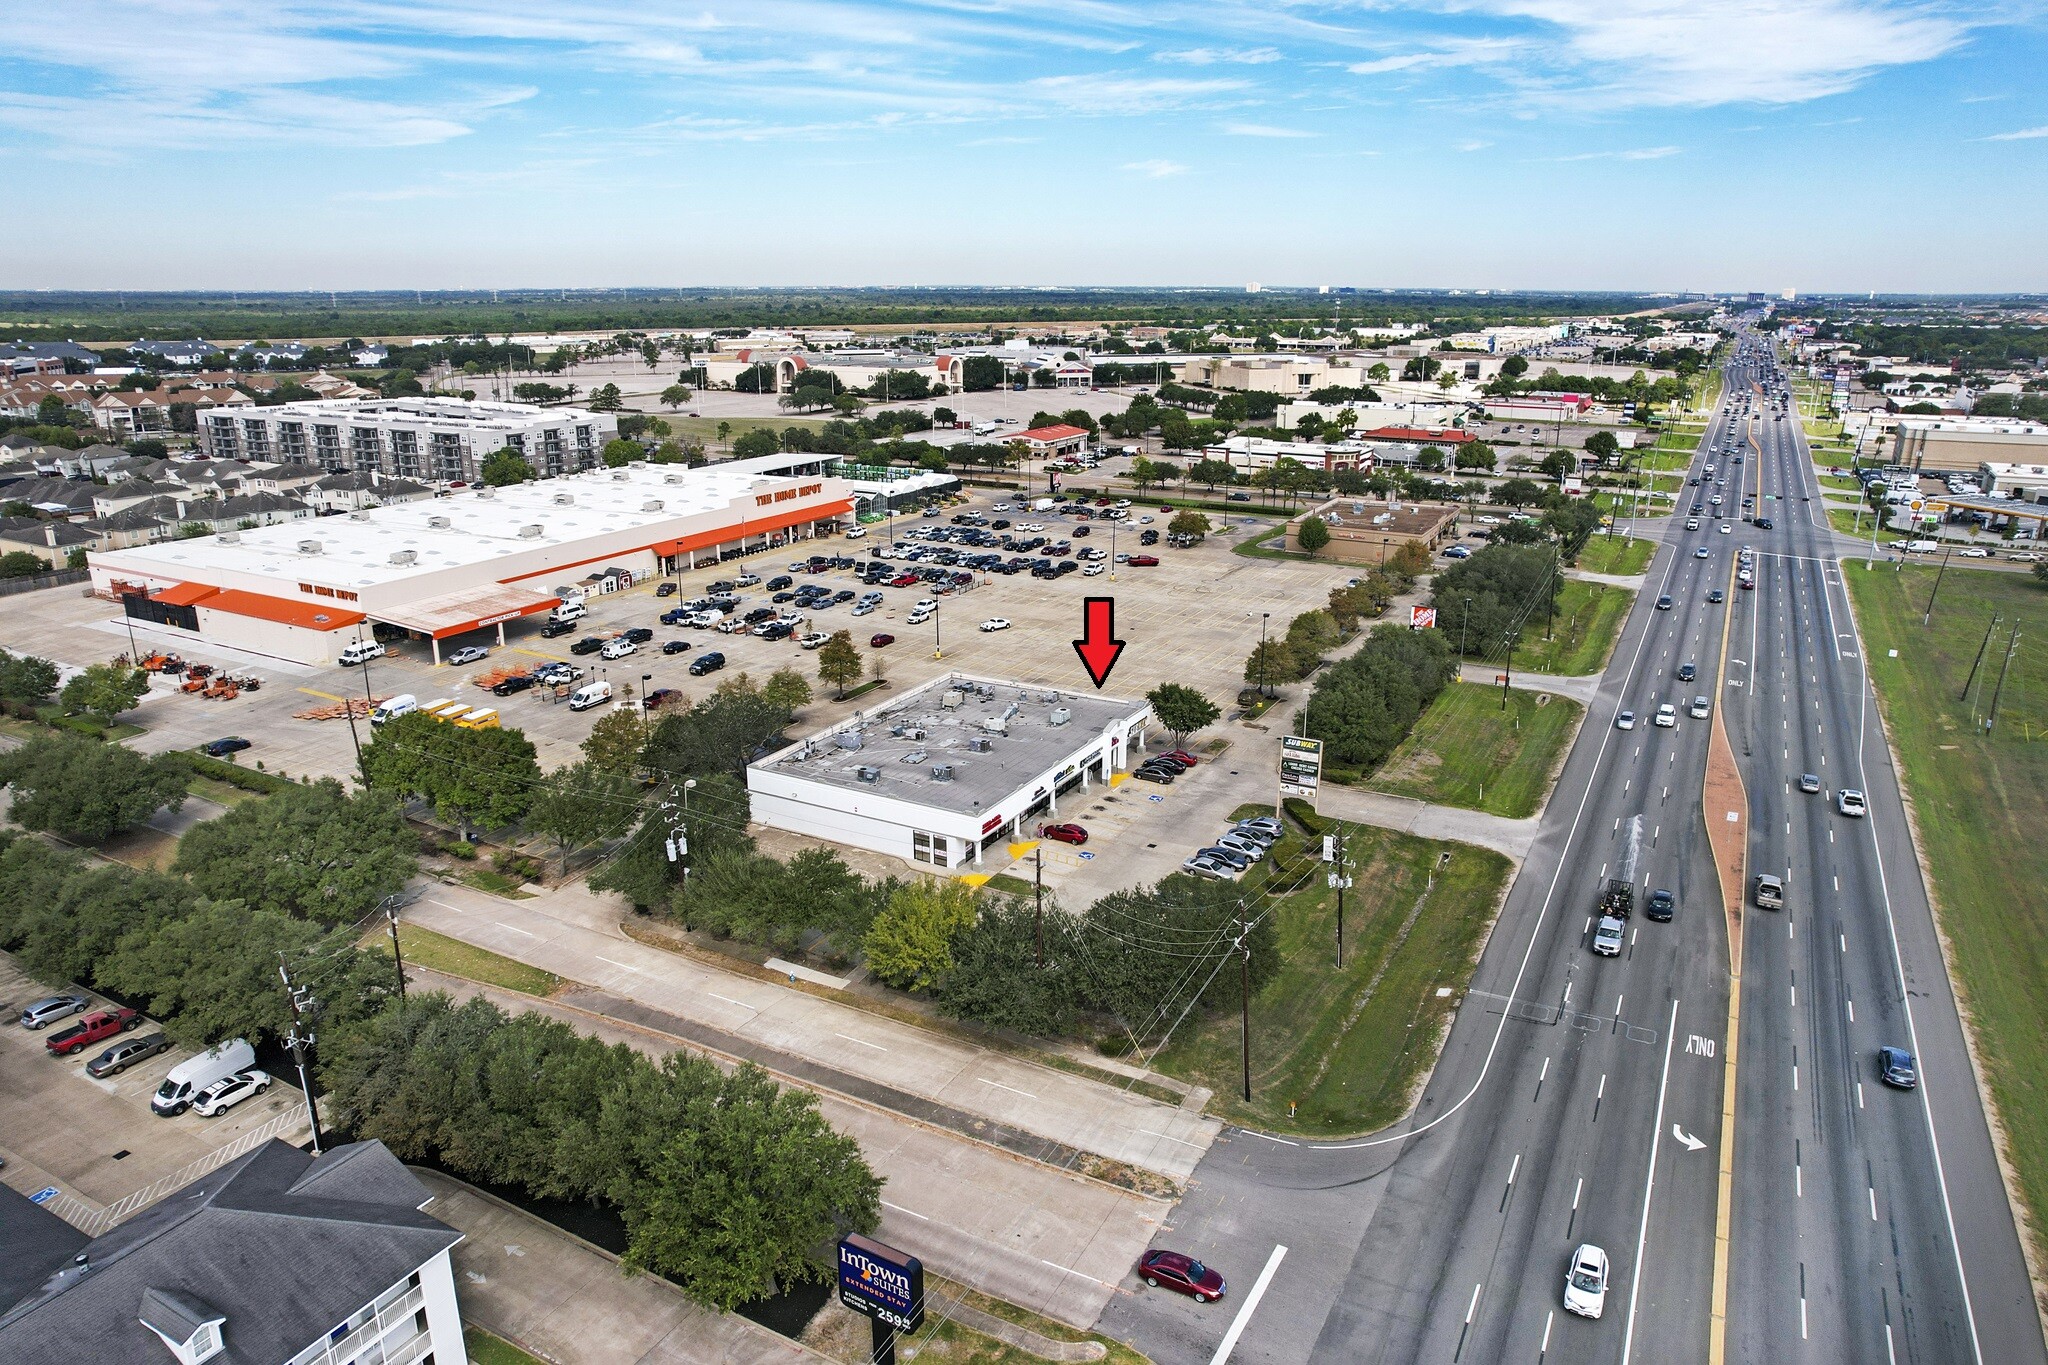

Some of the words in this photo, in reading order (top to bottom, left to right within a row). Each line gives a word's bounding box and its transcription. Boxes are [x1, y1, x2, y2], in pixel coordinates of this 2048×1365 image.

[755, 493, 772, 507] THE
[774, 488, 797, 503] HOME
[798, 482, 822, 498] DEPOT
[298, 582, 313, 594] THE
[314, 585, 335, 598] HOME
[335, 588, 358, 602] DEPOT
[1413, 608, 1433, 626] HOME
[1842, 650, 1858, 658] ONLY
[1728, 679, 1744, 687] ONLY
[1285, 738, 1318, 750] SUBWAY
[1685, 1034, 1715, 1058] ONLY
[840, 1246, 910, 1291] InTown
[845, 1277, 885, 1299] EXTENDED
[886, 1295, 907, 1309] STAY
[873, 1277, 911, 1300] SUITES
[843, 1296, 868, 1312] KITCHENS
[844, 1291, 867, 1306] STUDIOS
